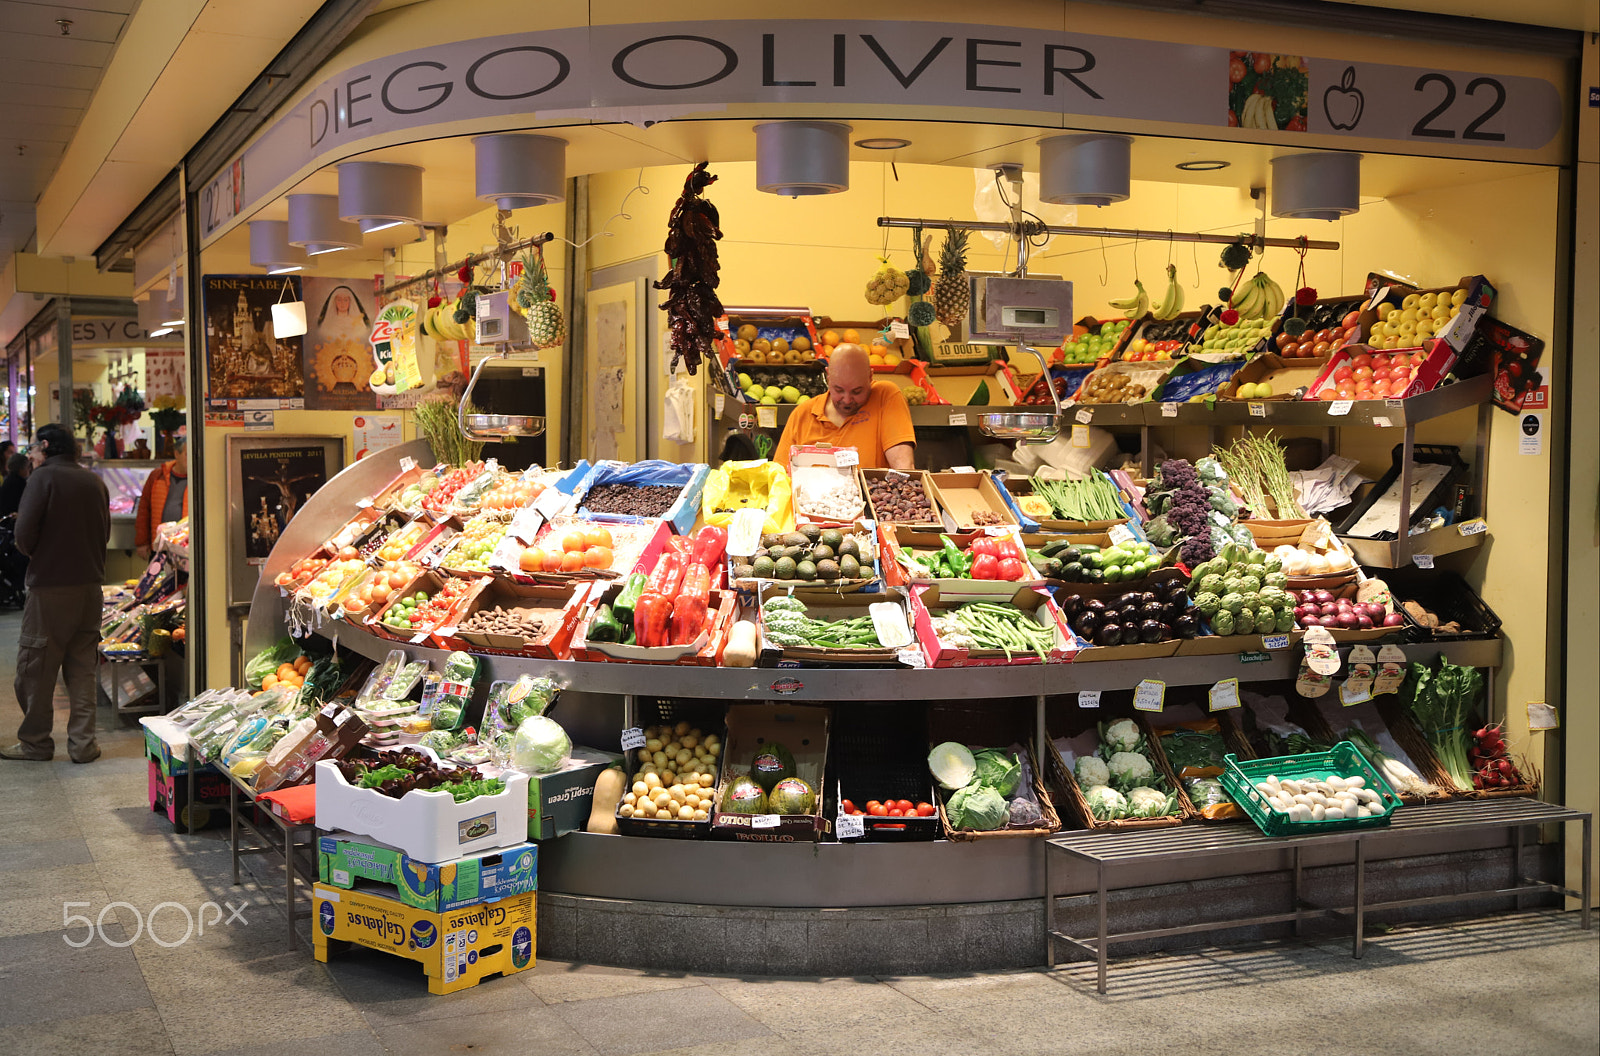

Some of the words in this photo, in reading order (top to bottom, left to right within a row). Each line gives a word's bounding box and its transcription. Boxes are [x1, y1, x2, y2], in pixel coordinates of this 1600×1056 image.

[310, 45, 571, 149] DIEGO
[611, 33, 1105, 100] OLIVER
[1411, 73, 1507, 142] 22
[205, 177, 221, 233] 22
[269, 451, 303, 459] PENITENTE
[547, 792, 570, 804] Green
[735, 832, 794, 842] BOLLO
[347, 911, 406, 946] Galdense
[450, 906, 506, 931] Galdense
